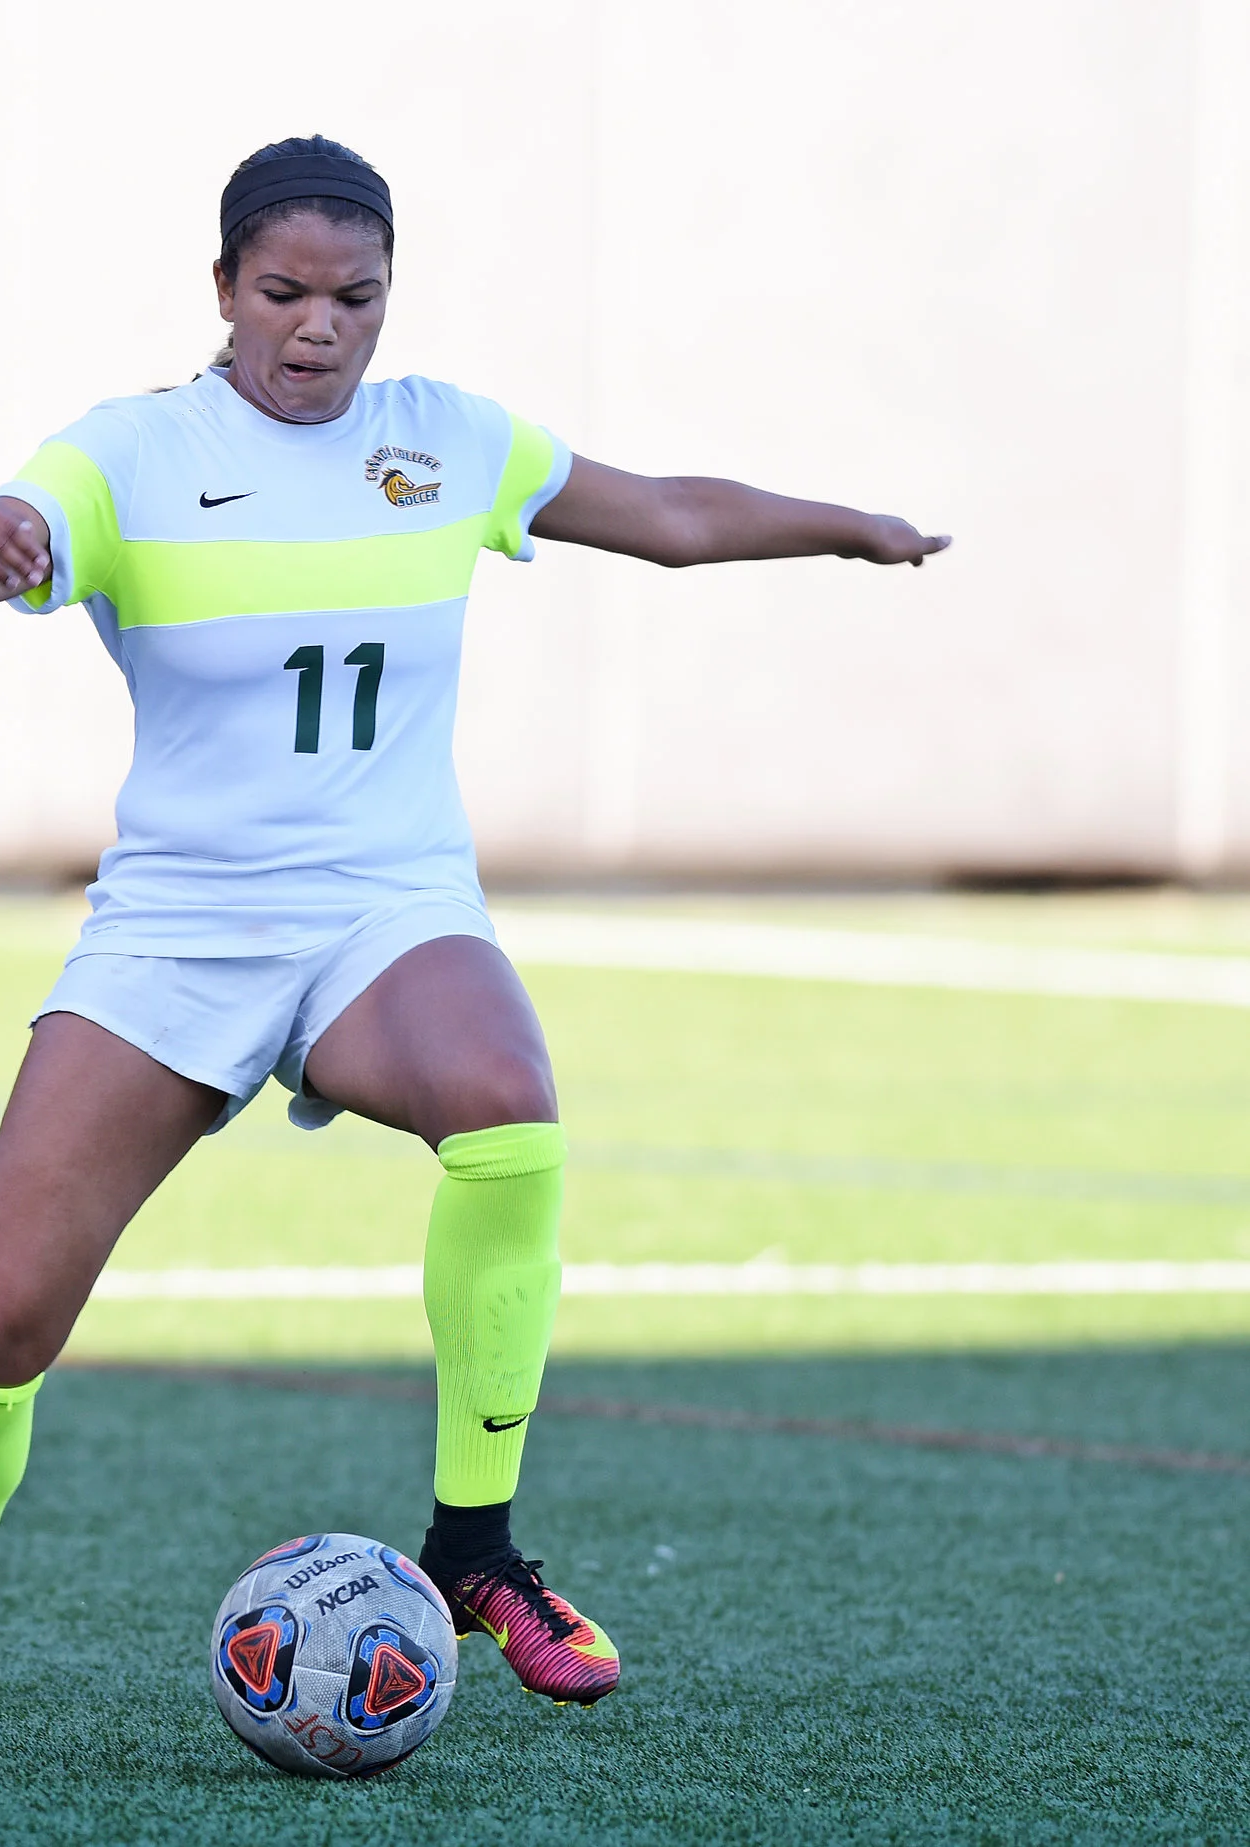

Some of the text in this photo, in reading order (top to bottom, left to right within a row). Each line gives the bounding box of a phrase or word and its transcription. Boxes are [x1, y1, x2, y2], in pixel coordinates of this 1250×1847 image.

[393, 447, 441, 471] COLLEGE
[397, 490, 438, 506] SOCCER
[283, 642, 385, 754] 11
[284, 1551, 363, 1590] Wilson
[315, 1575, 380, 1616] NCAA
